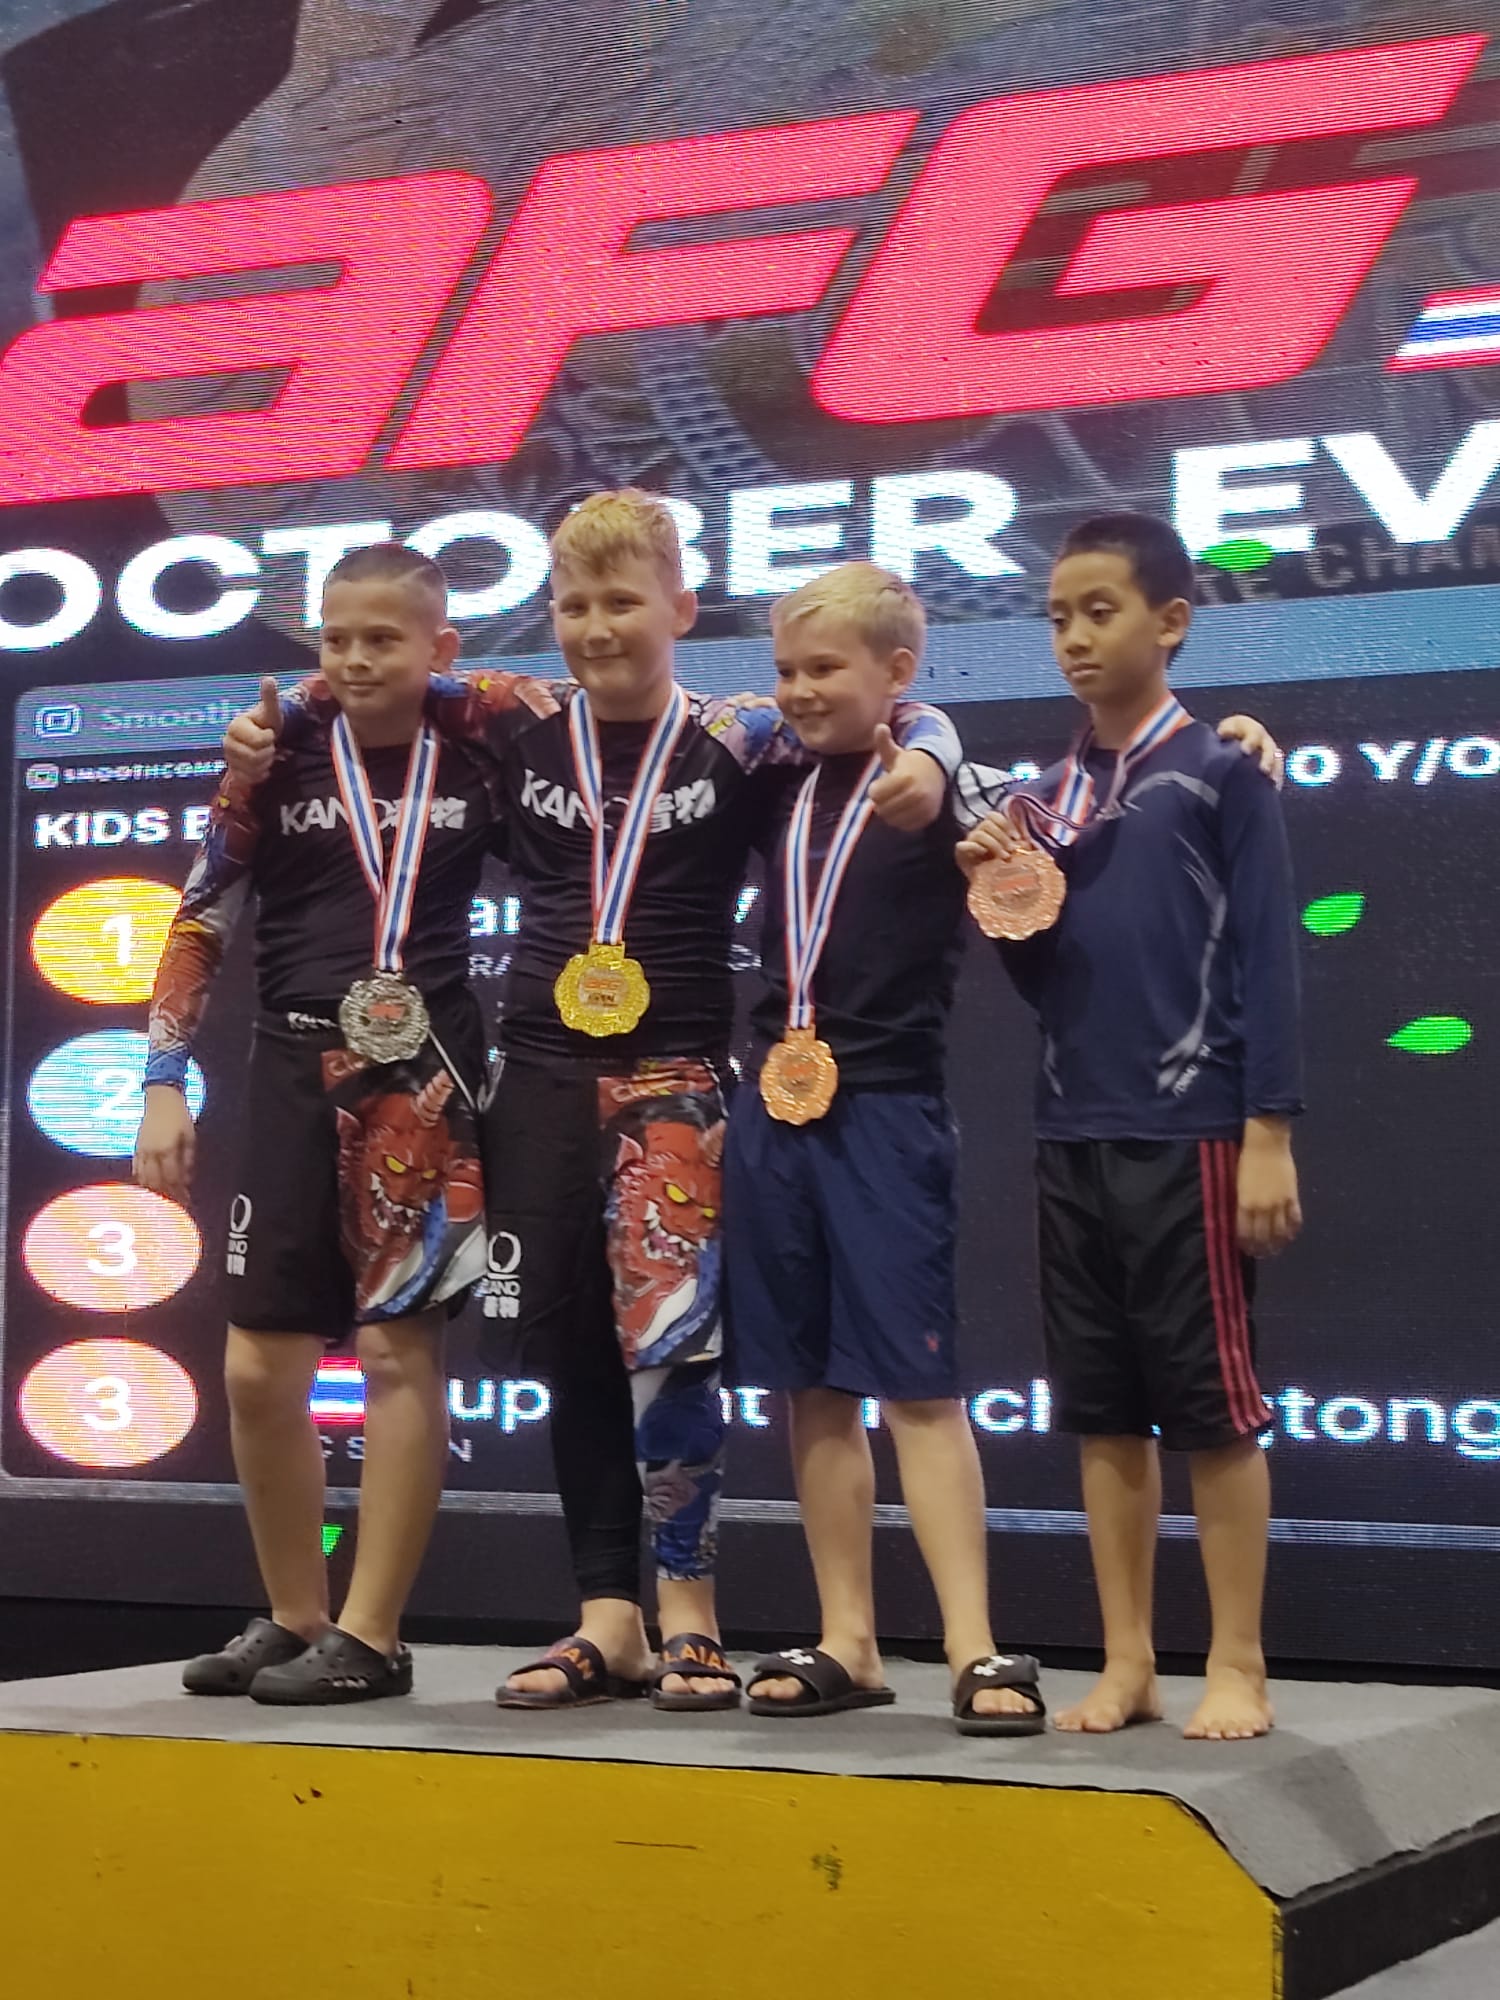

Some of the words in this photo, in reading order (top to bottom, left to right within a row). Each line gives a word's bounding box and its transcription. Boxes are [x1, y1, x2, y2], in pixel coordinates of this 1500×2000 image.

[34, 807, 172, 848] KIDS
[1356, 734, 1500, 786] Y/O
[102, 915, 132, 966] 1
[96, 1067, 141, 1120] 2
[87, 1221, 137, 1275] 3
[84, 1375, 132, 1431] 3
